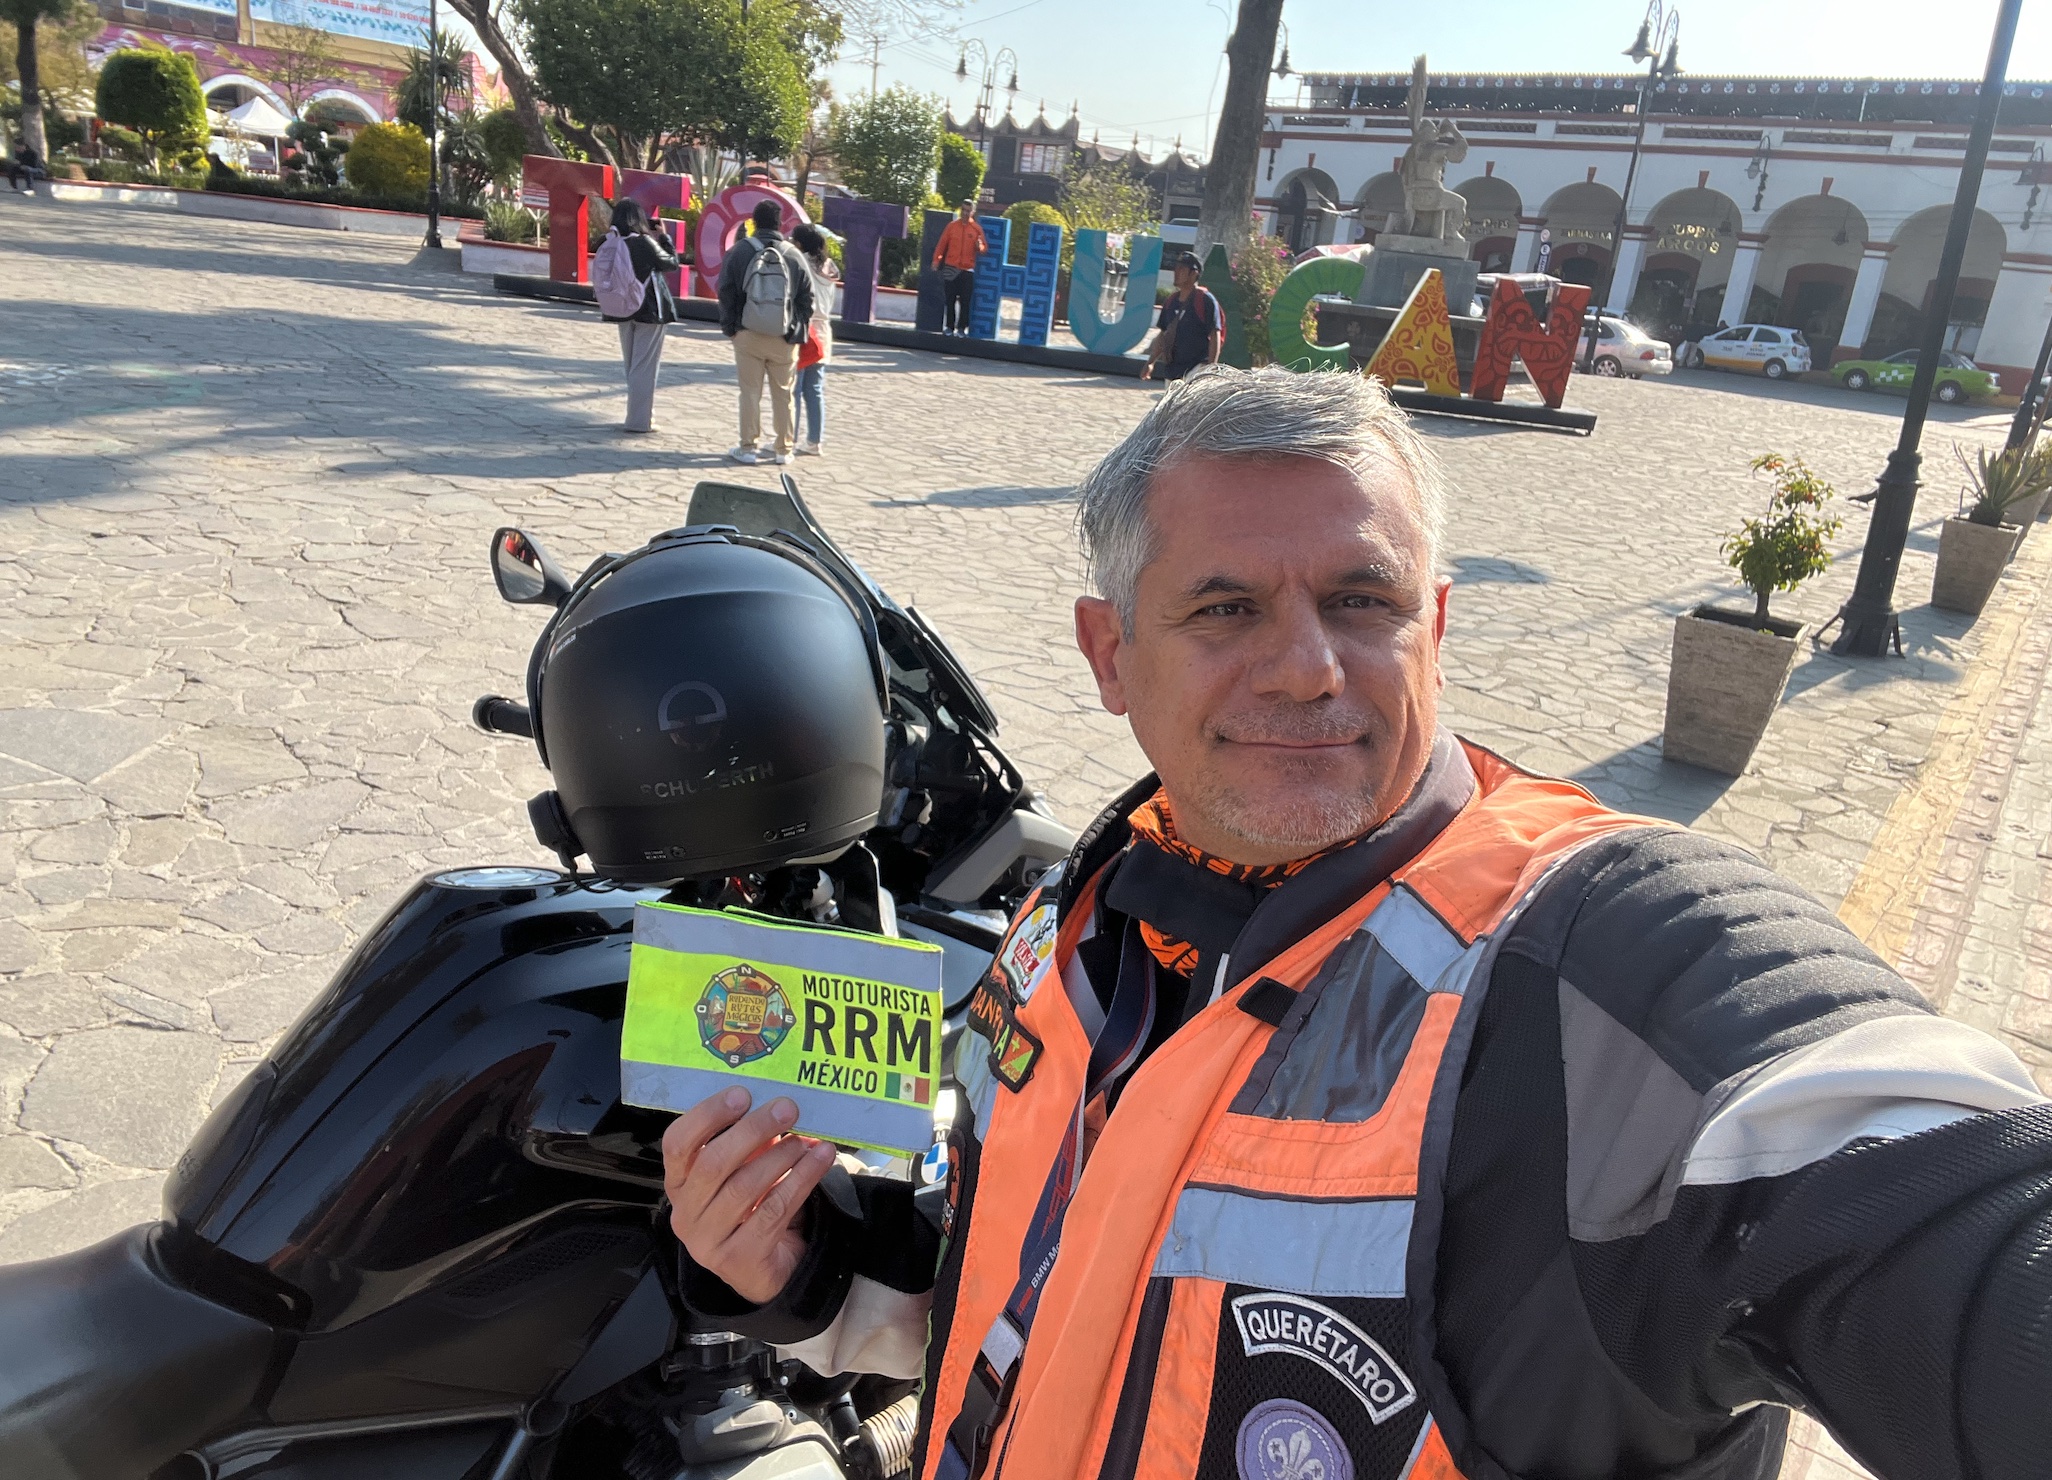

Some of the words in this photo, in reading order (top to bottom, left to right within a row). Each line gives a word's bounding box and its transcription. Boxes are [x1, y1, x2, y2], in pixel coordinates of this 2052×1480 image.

[1656, 237, 1720, 254] ARCOS
[639, 761, 775, 798] SCHUERTH
[740, 966, 752, 975] N
[696, 1004, 707, 1013] O
[802, 974, 933, 1017] MOTOTURISTA
[784, 1014, 794, 1023] E
[801, 998, 932, 1074] RRM
[729, 1054, 740, 1064] S
[797, 1059, 878, 1094] MÉXICO
[1031, 1257, 1050, 1289] BMW
[1247, 1308, 1396, 1404] QUERÉTARO
